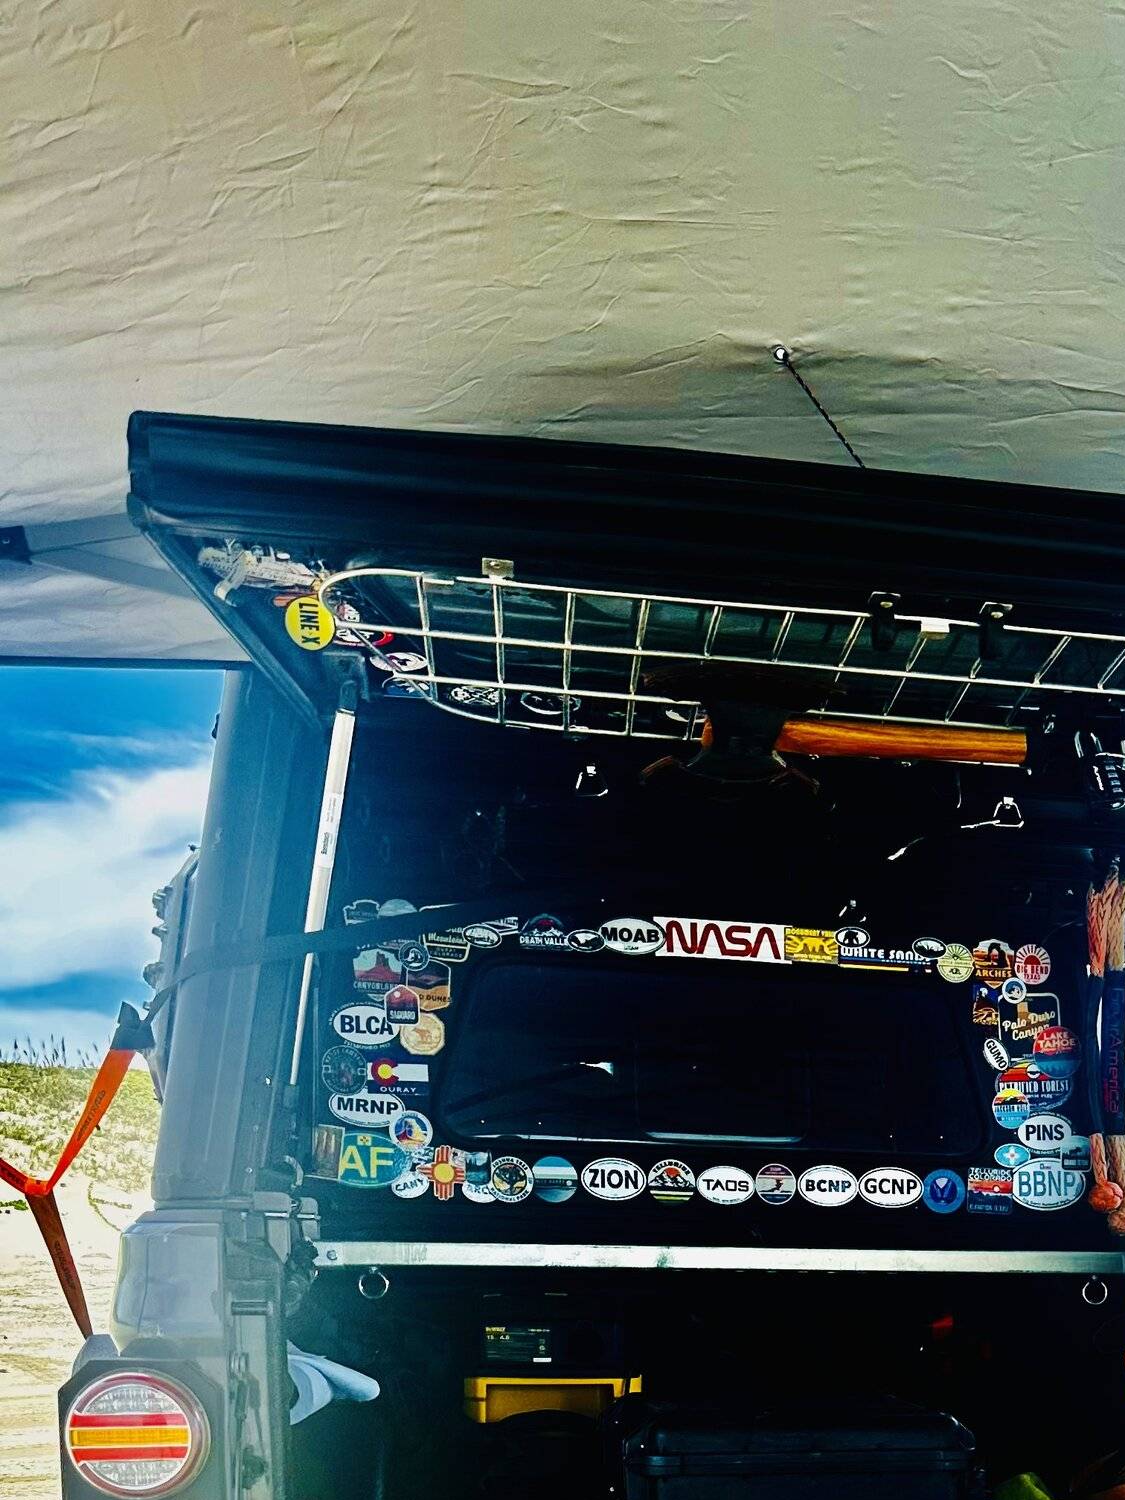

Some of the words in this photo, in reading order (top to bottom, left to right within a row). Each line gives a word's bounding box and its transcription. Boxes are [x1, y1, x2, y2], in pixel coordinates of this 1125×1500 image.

[519, 936, 543, 946] DEATH
[600, 926, 660, 943] MOAB
[665, 920, 782, 960] NASA
[840, 946, 885, 959] WHITE
[975, 969, 1013, 978] ARCHES
[1016, 964, 1029, 975] BIG
[1031, 964, 1049, 975] BEND
[389, 1010, 416, 1020] SAGUARO
[1002, 1018, 1027, 1033] Palo
[1027, 1010, 1056, 1025] Duro
[339, 1014, 394, 1036] BLCA
[1043, 1031, 1070, 1040] LAKE
[1037, 1039, 1077, 1049] TAHOE
[985, 1039, 1008, 1070] GUMO
[380, 1086, 417, 1094] OURAY
[1041, 1079, 1069, 1093] FOREST
[336, 1096, 399, 1116] MRNP
[1025, 1123, 1065, 1142] PINS
[338, 1144, 395, 1179] AF
[652, 1160, 691, 1175] TELLURIDE
[588, 1168, 640, 1190] ZION
[969, 1167, 1012, 1176] TELLURIDE
[395, 1178, 424, 1192] CANY
[701, 1178, 750, 1192] TAOS
[805, 1178, 852, 1194] BCNP
[864, 1177, 918, 1195] GCNP
[1018, 1170, 1076, 1197] BBNP
